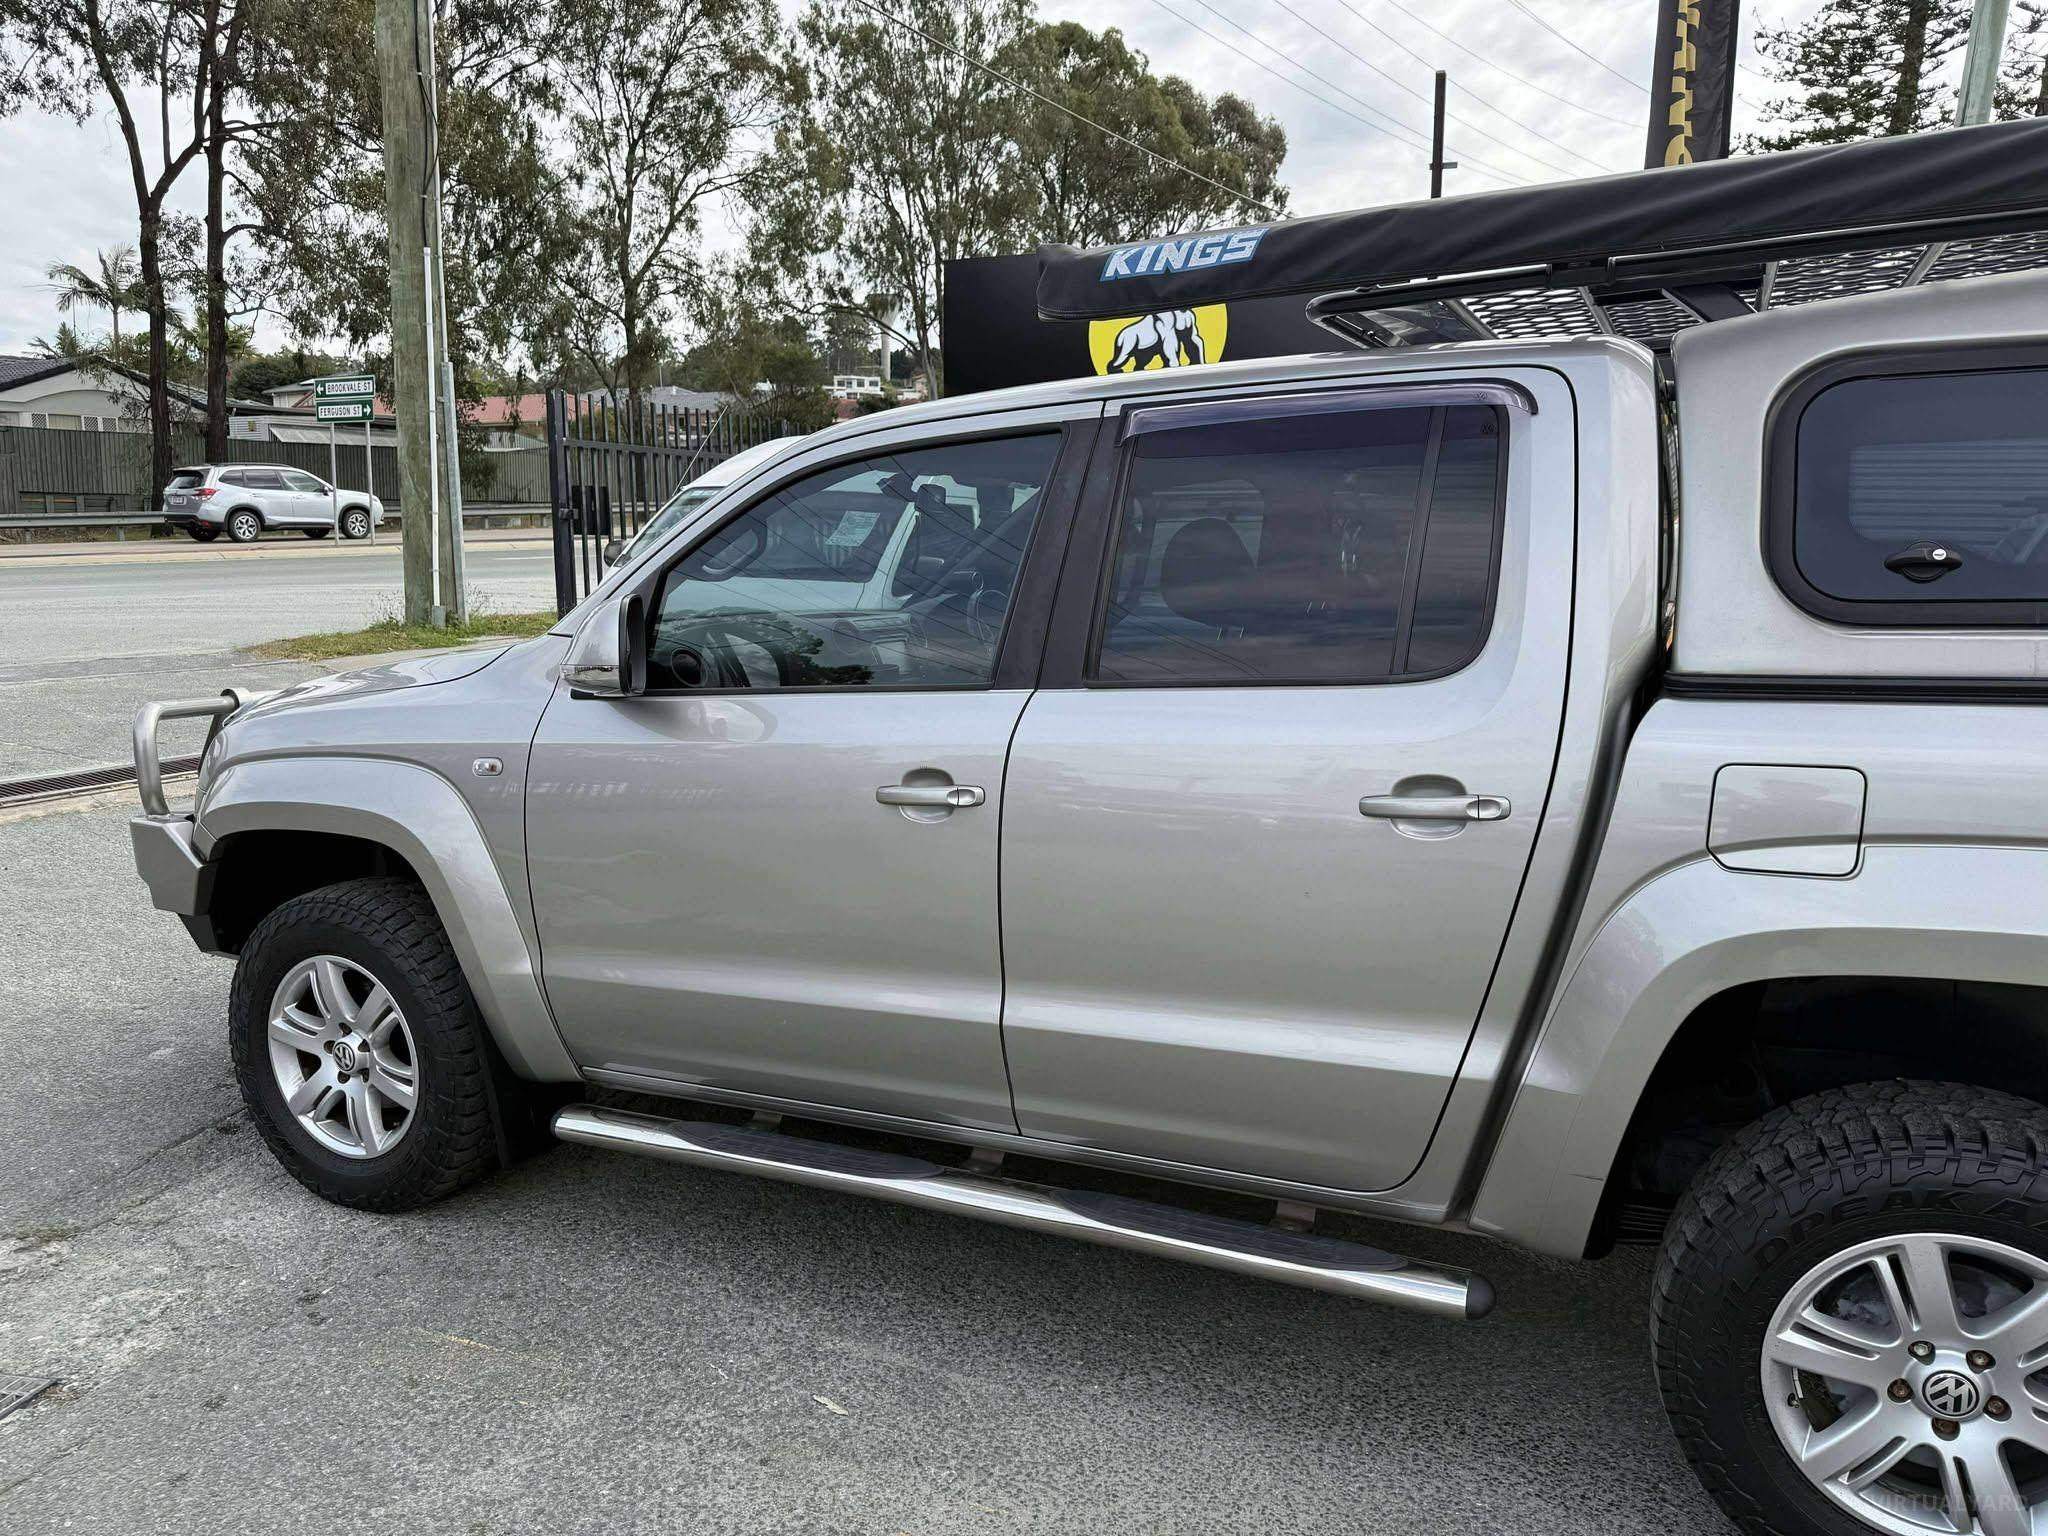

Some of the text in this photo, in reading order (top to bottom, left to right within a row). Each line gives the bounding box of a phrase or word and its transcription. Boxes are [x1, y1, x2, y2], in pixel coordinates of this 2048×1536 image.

[1102, 229, 1268, 279] KINGS
[327, 381, 371, 393] BROOKVALE ST
[320, 406, 360, 416] FERGUSON ST
